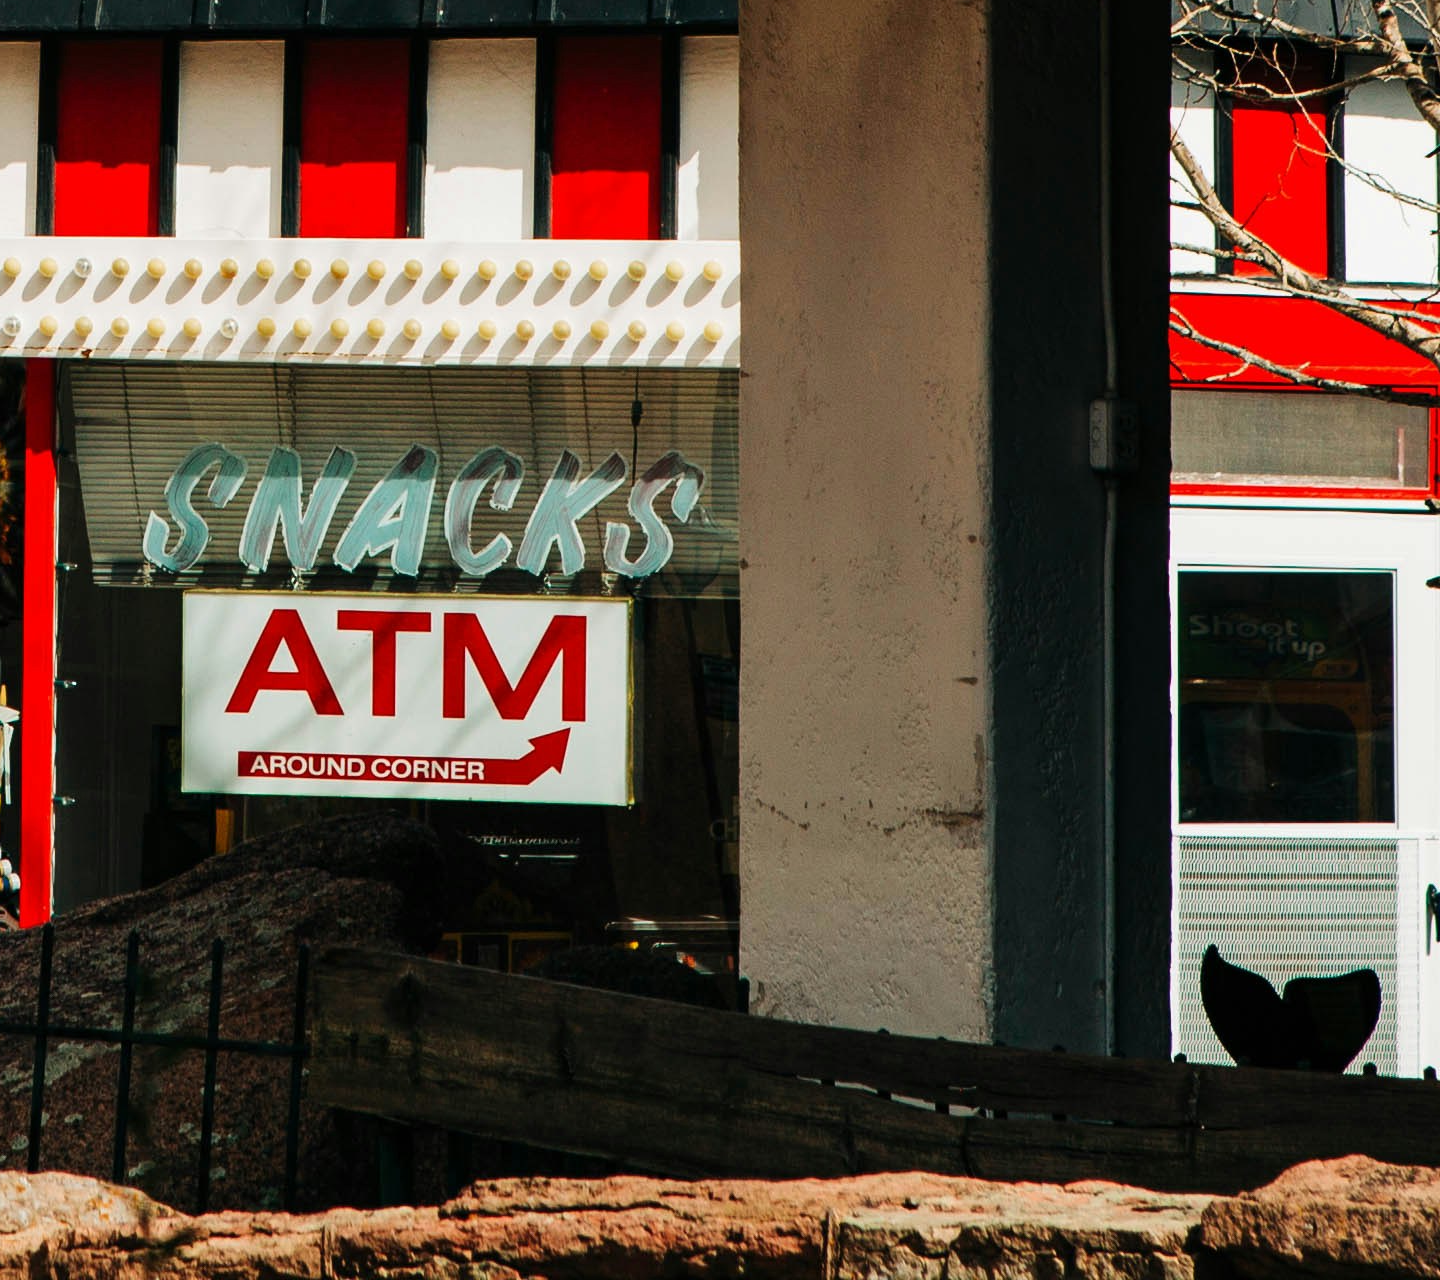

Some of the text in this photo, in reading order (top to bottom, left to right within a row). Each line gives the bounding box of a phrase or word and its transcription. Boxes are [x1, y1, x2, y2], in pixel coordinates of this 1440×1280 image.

[142, 443, 706, 580] SNACKS
[1189, 614, 1300, 638] Shoot
[224, 608, 587, 723] ATM
[250, 754, 486, 782] AROUND CORNER
